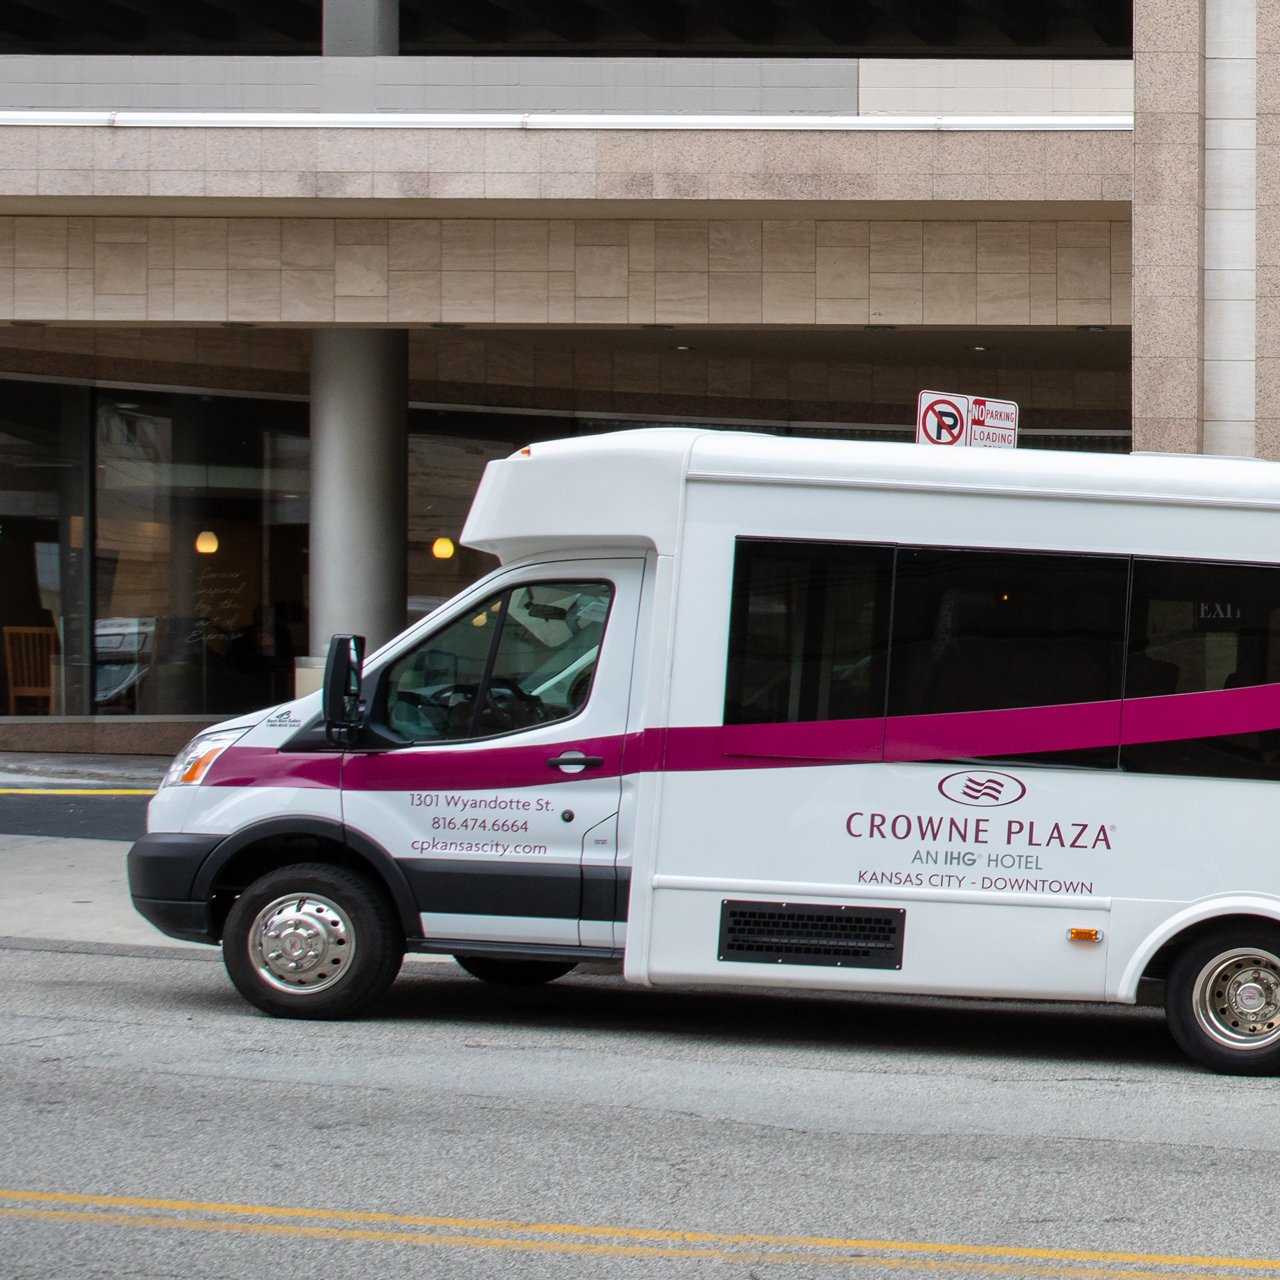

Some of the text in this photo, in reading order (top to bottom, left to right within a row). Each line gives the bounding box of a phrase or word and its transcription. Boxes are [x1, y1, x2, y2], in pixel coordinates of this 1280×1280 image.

[972, 404, 1015, 423] NO PARKING
[973, 430, 1013, 445] LOADING
[410, 793, 555, 812] 1301 Wyandotte St.
[431, 816, 529, 833] 816.474.6664
[846, 812, 990, 844] CROWNE
[411, 836, 548, 857] cpkansascity.com
[911, 849, 939, 865] AN
[987, 853, 1043, 870] HOTEL
[857, 870, 924, 886] KANSAS
[928, 873, 967, 889] CITY
[981, 876, 1093, 895] DOWNTOWN
